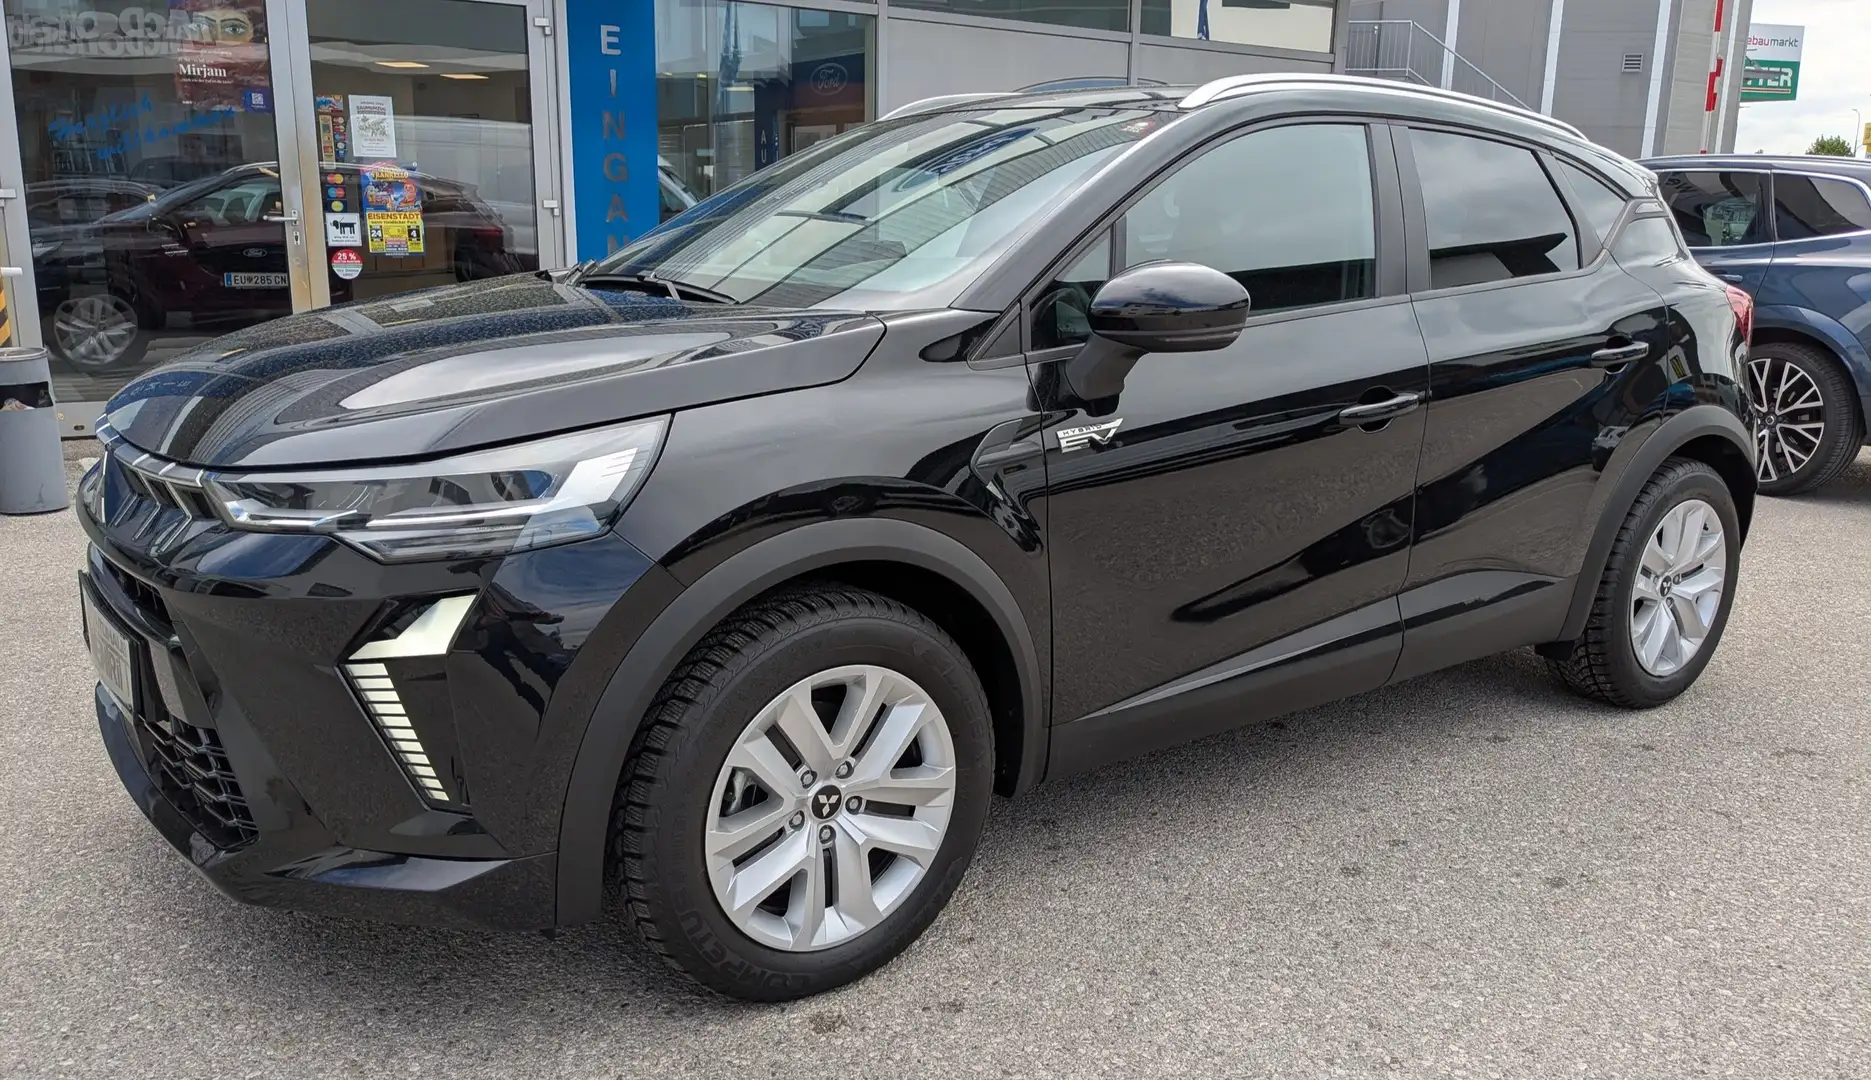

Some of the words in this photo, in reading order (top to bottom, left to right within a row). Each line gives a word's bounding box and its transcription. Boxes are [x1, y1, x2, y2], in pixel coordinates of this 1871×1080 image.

[178, 64, 227, 78] Mirjam
[367, 212, 420, 220] EISENSTADT
[371, 229, 382, 238] 24
[410, 230, 417, 239] 4
[233, 275, 246, 285] EU
[253, 275, 273, 285] 285
[274, 275, 287, 285] CN
[1062, 423, 1102, 437] HYBRID
